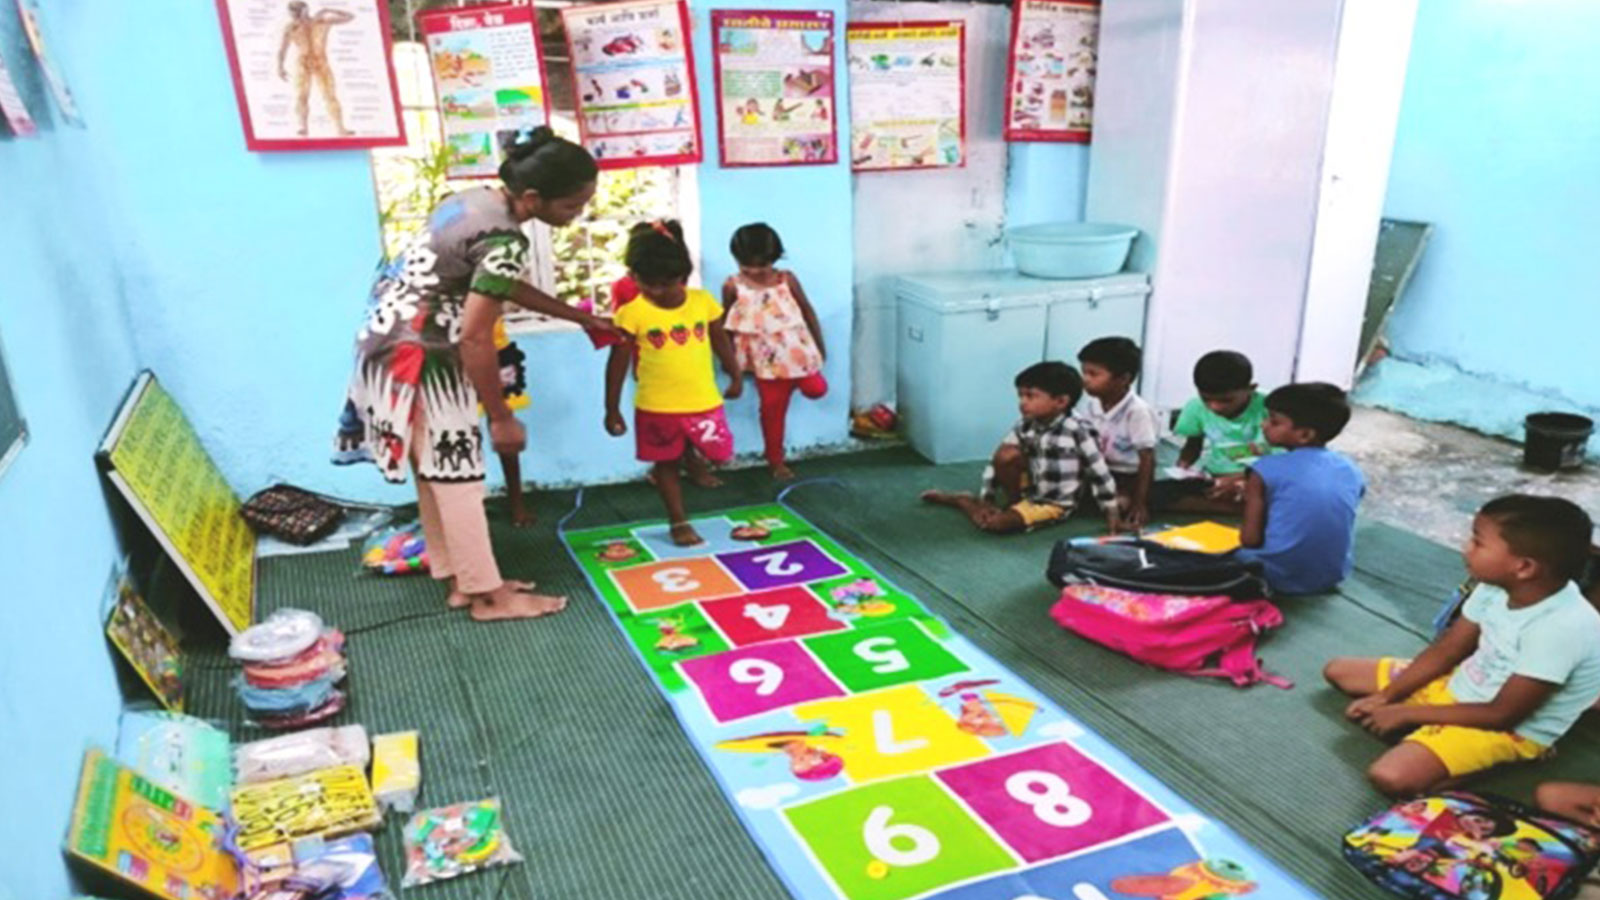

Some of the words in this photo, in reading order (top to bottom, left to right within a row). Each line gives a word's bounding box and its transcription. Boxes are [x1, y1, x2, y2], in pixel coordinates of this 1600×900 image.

[698, 419, 720, 443] 2
[652, 567, 701, 593] 3
[754, 551, 804, 575] 2
[744, 603, 790, 630] 4
[854, 638, 908, 673] 5
[729, 658, 783, 695] 6
[873, 710, 926, 754] 7
[1005, 770, 1092, 827] 8
[864, 807, 940, 866] 9
